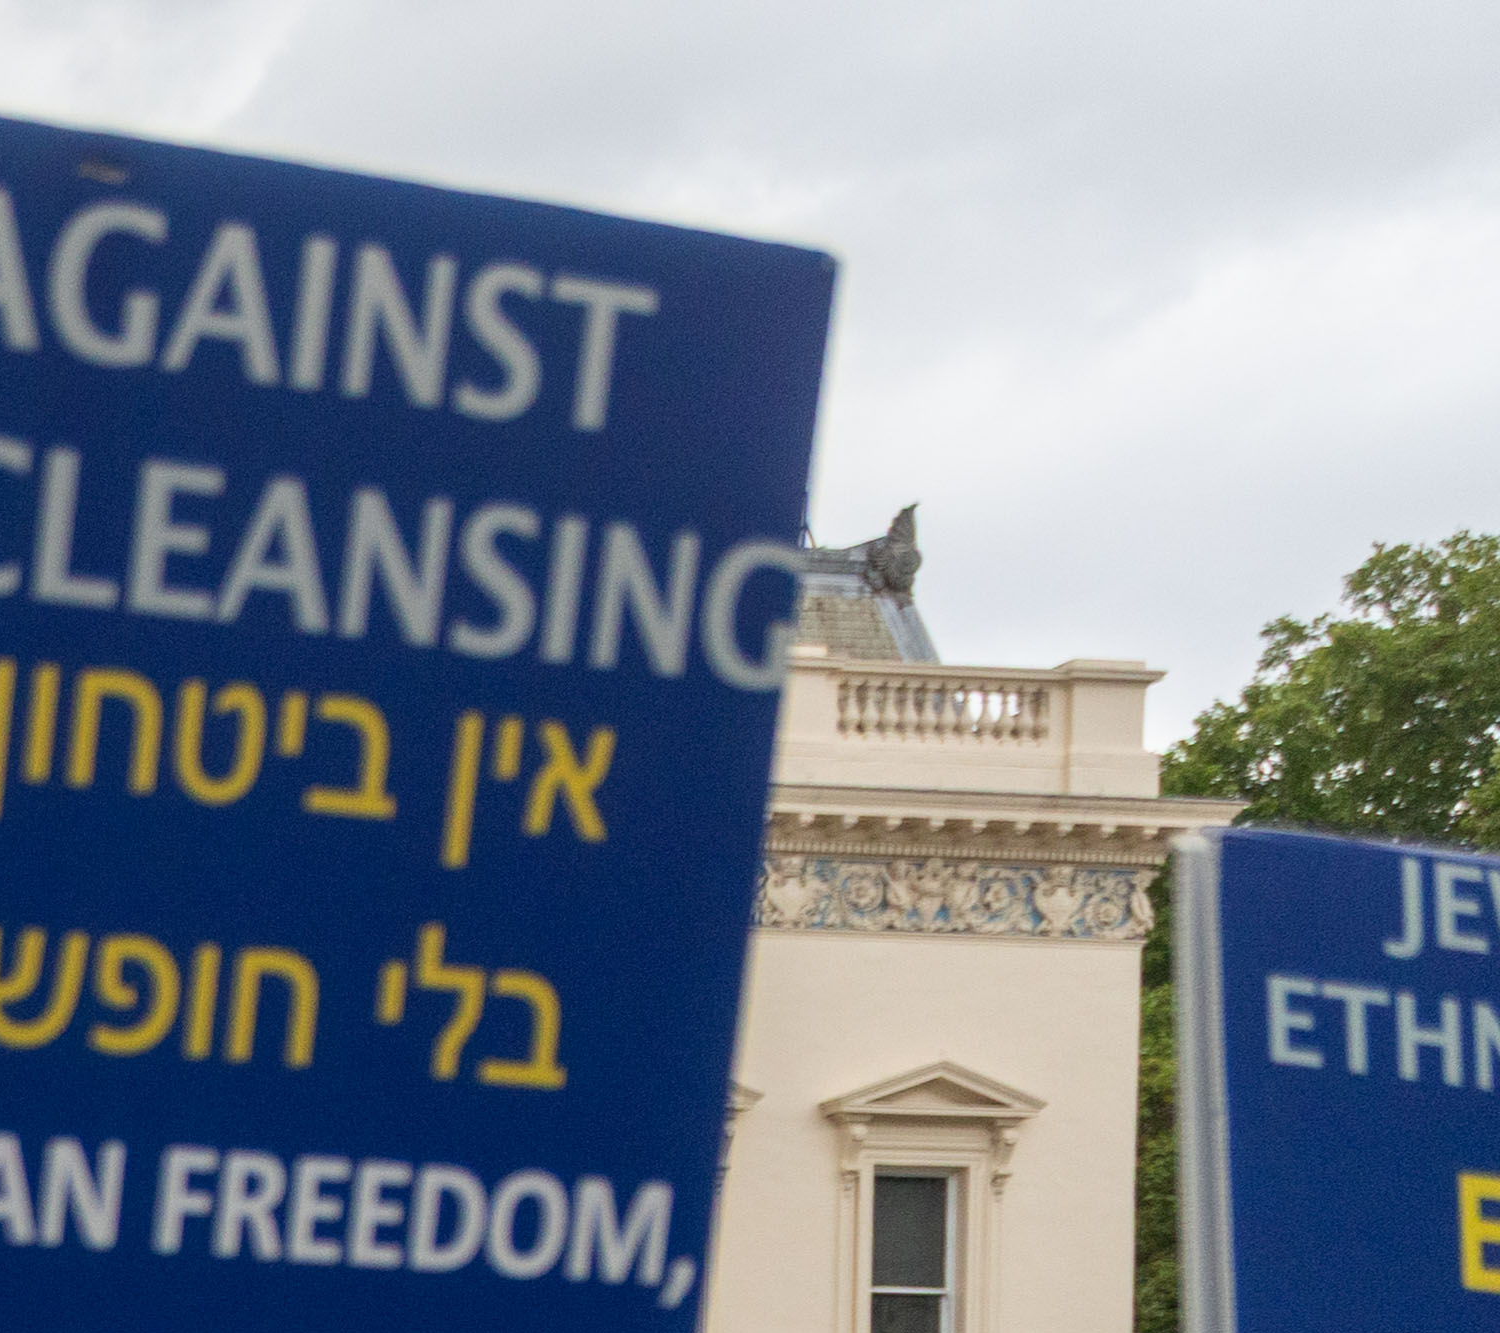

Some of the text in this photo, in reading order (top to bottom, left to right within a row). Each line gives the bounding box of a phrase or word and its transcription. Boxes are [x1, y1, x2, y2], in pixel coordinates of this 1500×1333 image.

[444, 711, 616, 868] אין
[1384, 856, 1500, 959] JE
[376, 922, 565, 1090] בלי
[153, 1147, 701, 1308] FREEDOM,
